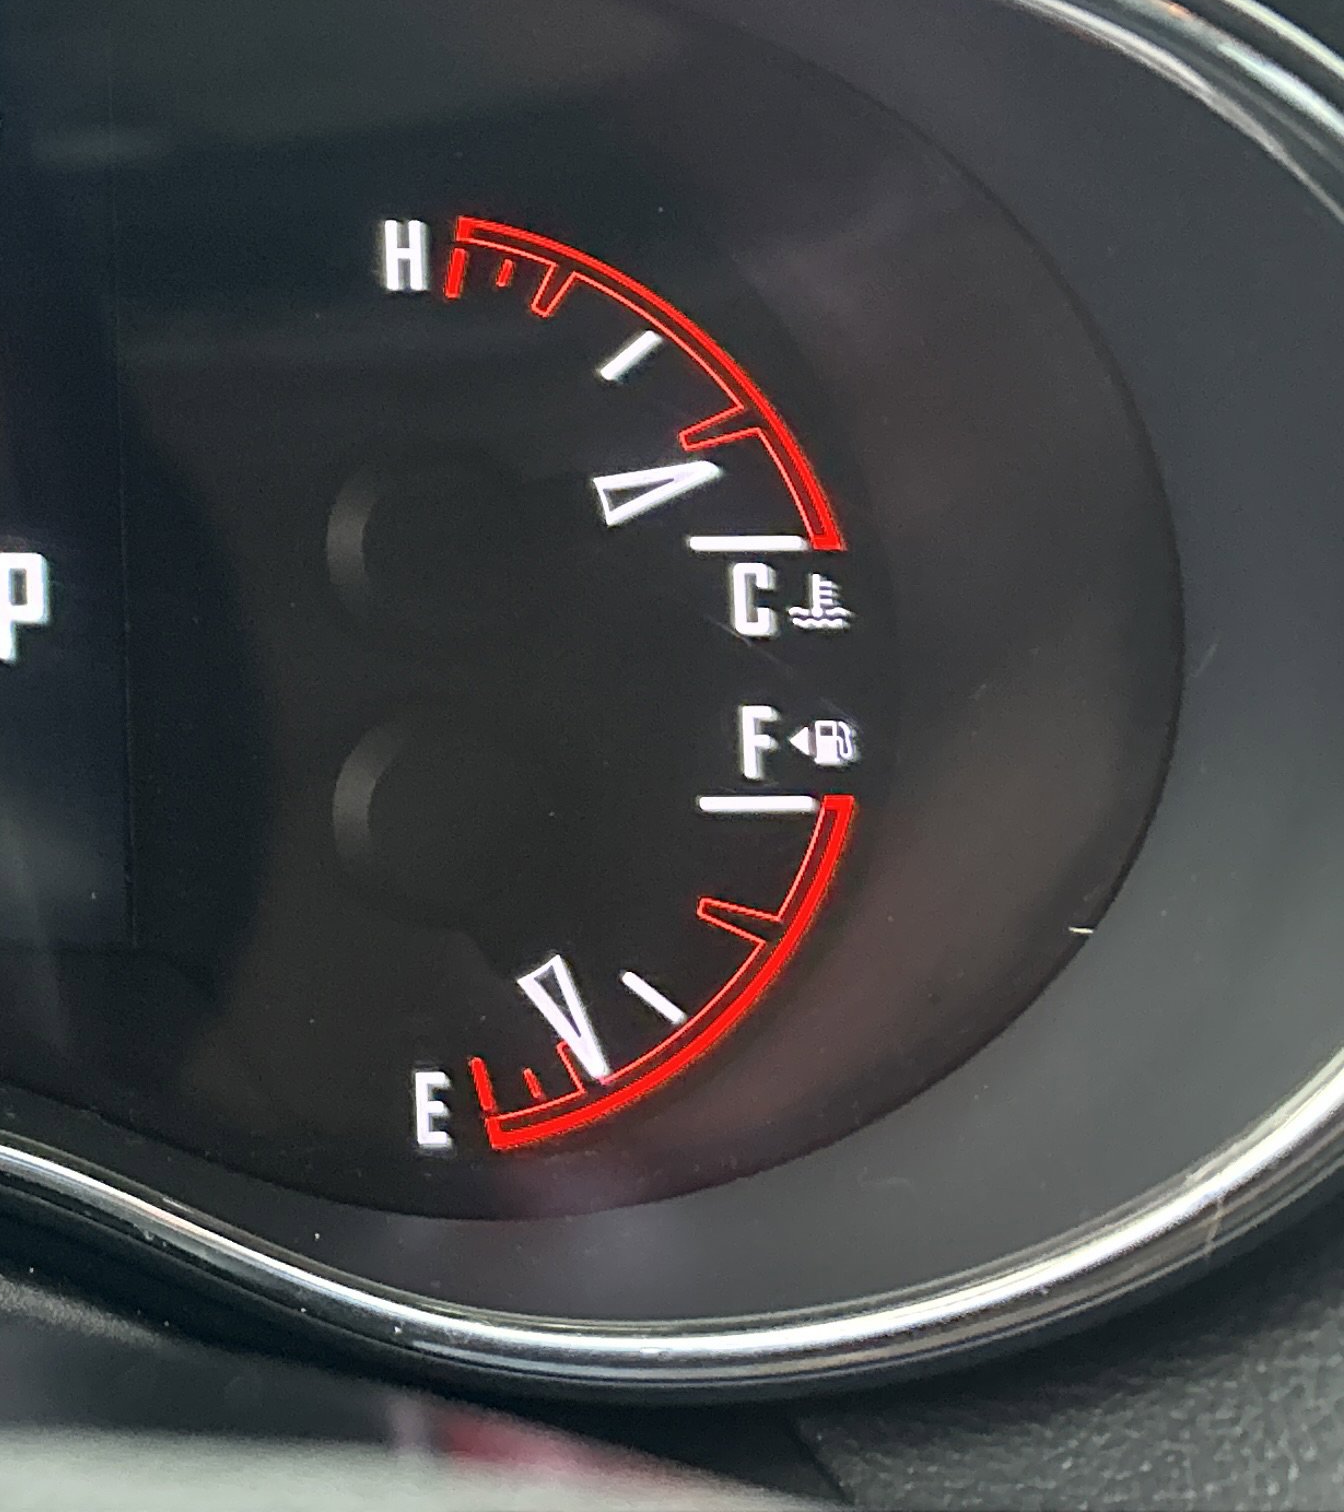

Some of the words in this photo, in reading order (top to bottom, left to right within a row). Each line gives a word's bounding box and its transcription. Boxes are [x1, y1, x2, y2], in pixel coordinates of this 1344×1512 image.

[382, 219, 429, 291] H
[730, 561, 774, 637] C
[739, 704, 776, 779] F
[414, 1070, 452, 1147] E
